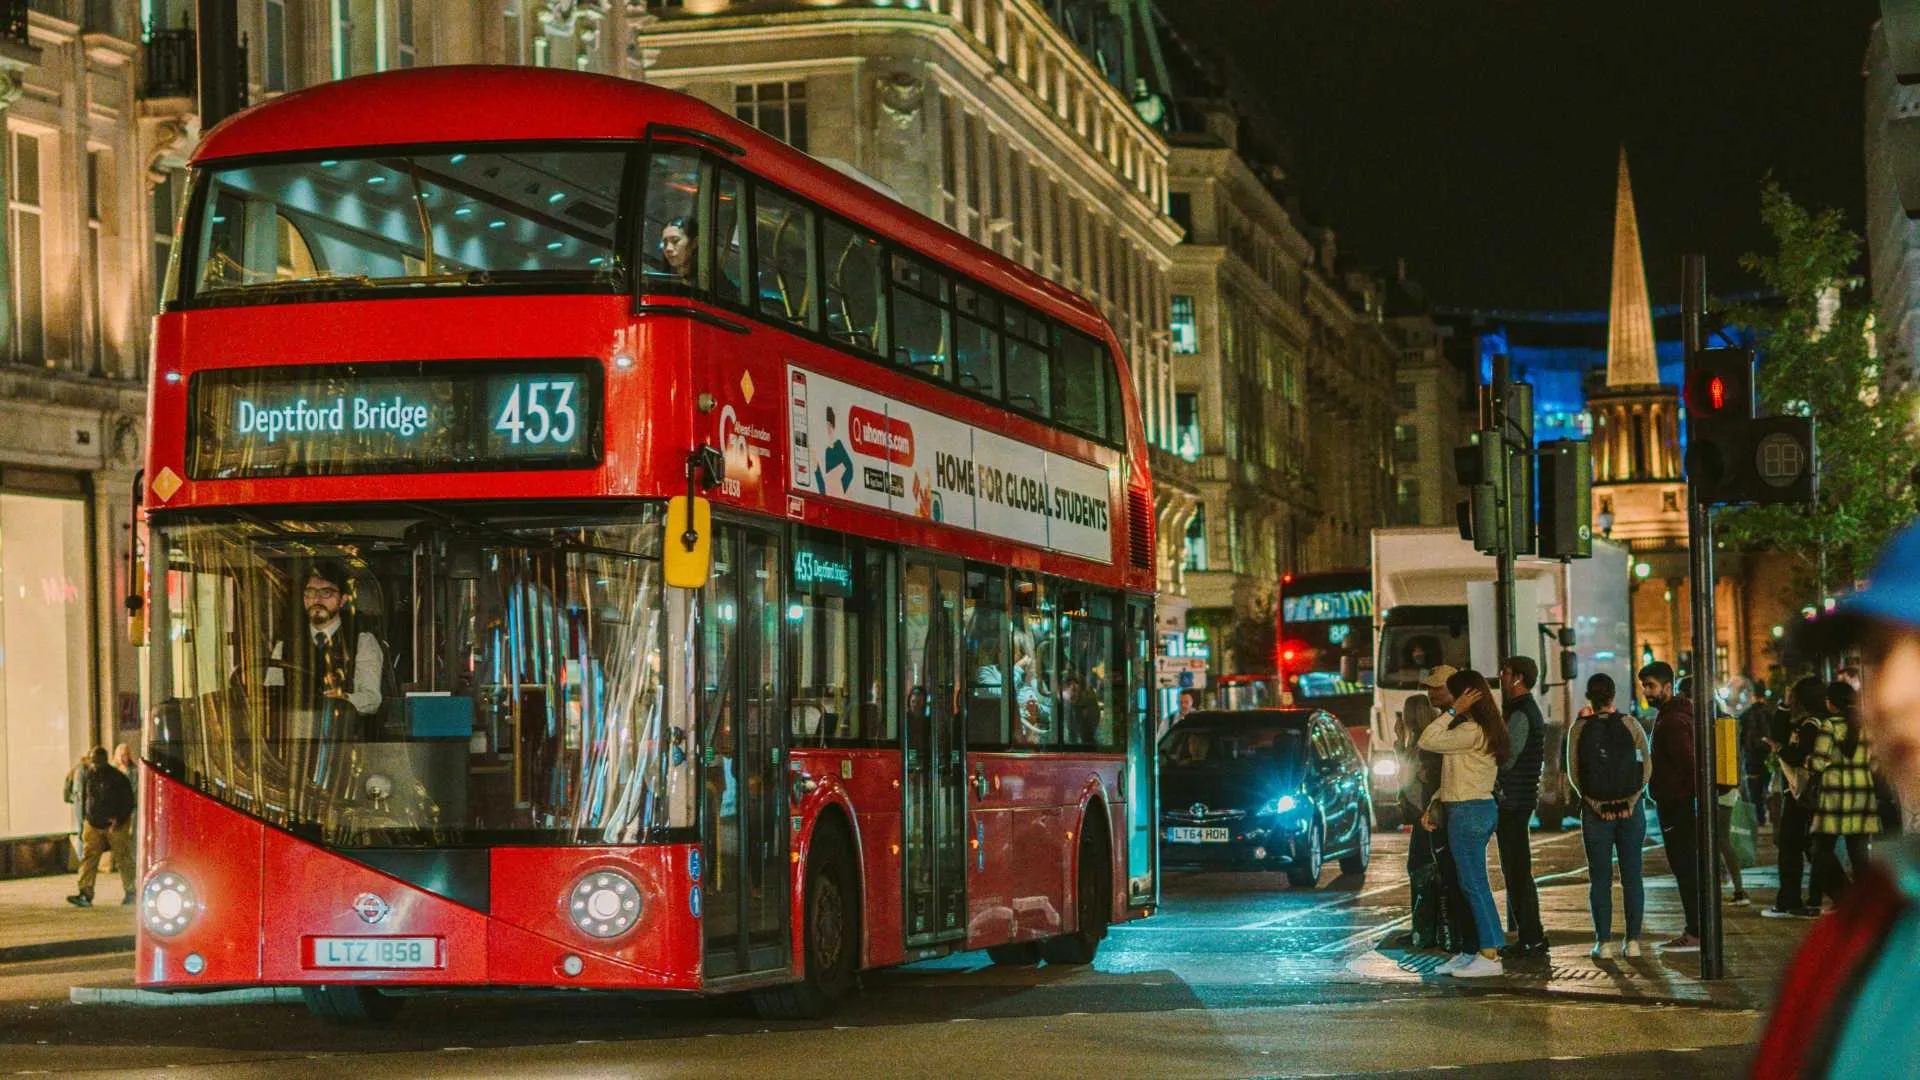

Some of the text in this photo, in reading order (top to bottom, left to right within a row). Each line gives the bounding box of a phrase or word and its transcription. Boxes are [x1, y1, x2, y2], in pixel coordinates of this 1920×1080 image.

[239, 397, 428, 442] Deptford Bridge
[495, 381, 576, 444] 453
[936, 451, 975, 497] HOME
[977, 464, 1003, 504] FOR
[1005, 472, 1053, 517] GLOBAL
[1054, 487, 1108, 532] STUDENTS
[795, 552, 813, 581] 453
[1175, 829, 1203, 839] LT64
[328, 942, 368, 962] LTZ
